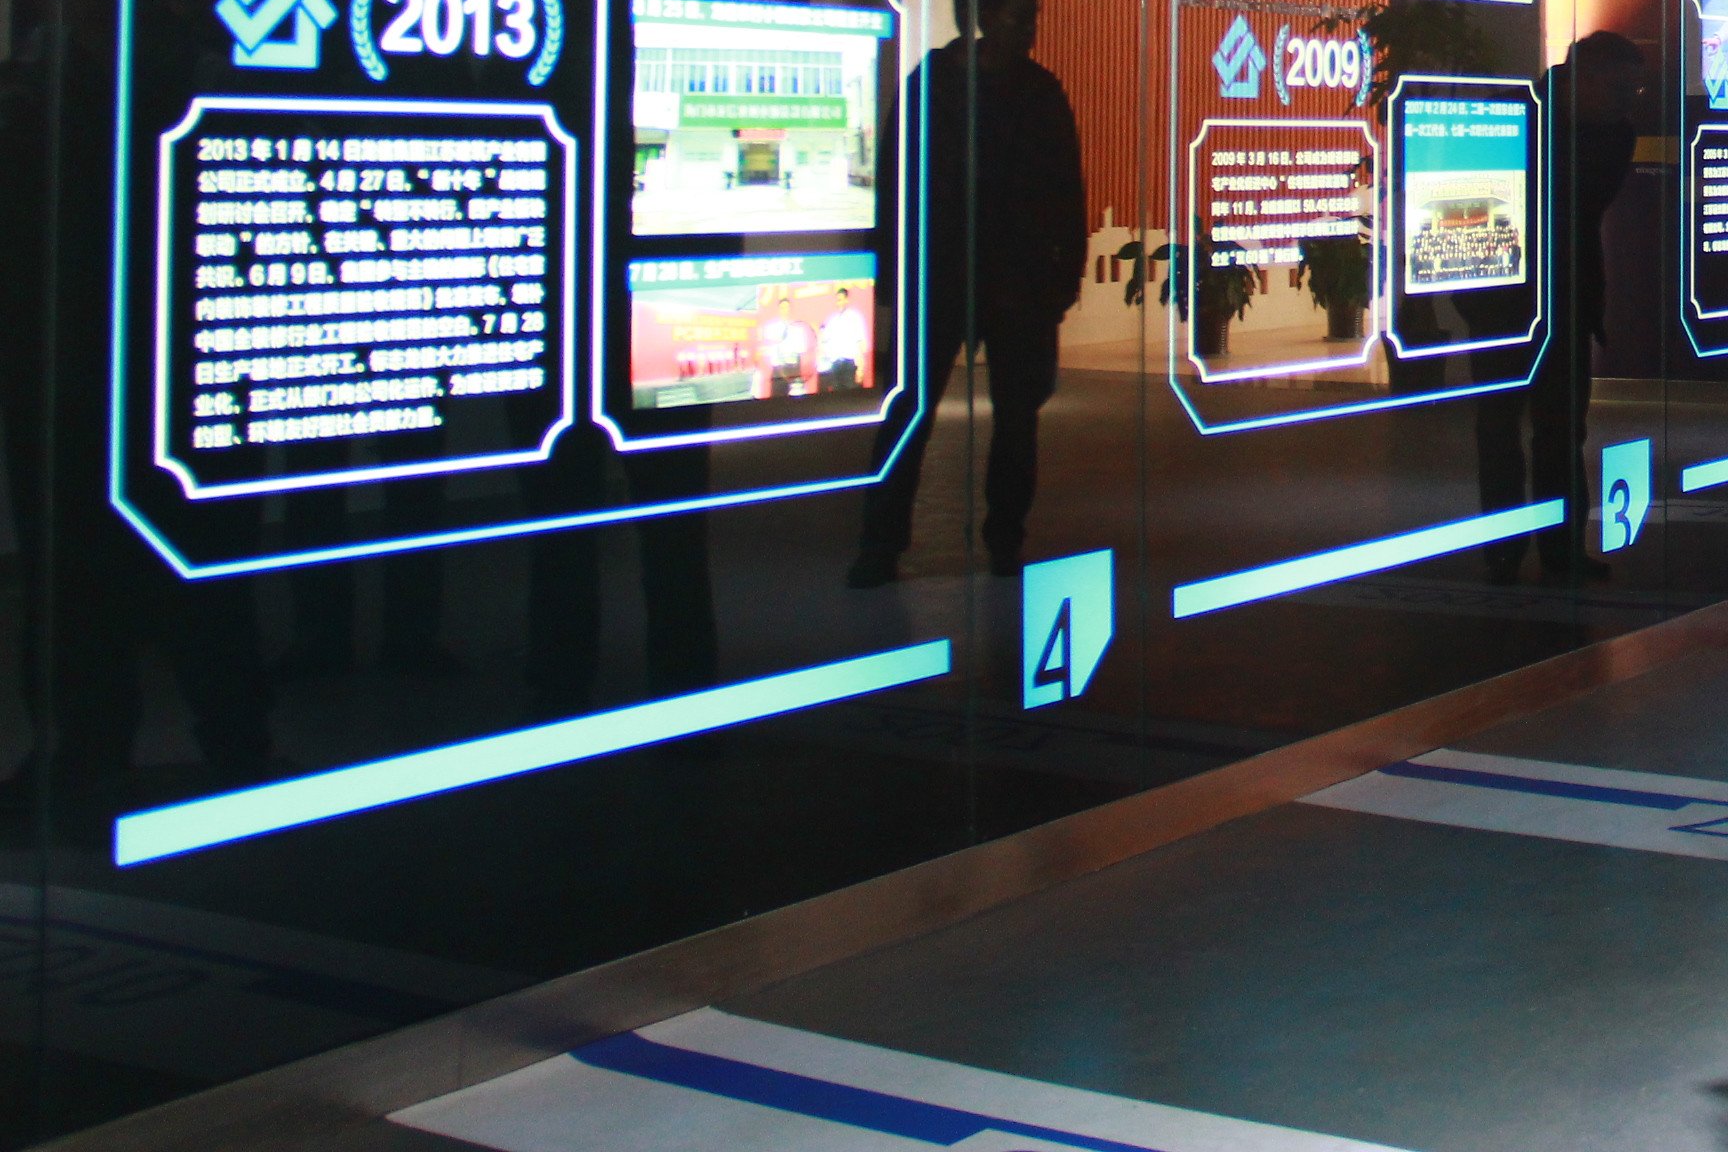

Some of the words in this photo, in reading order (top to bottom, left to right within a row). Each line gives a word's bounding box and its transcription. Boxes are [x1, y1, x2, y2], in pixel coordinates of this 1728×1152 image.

[1285, 36, 1361, 89] 2009
[1606, 478, 1635, 550] 3
[1031, 595, 1076, 700] 4
